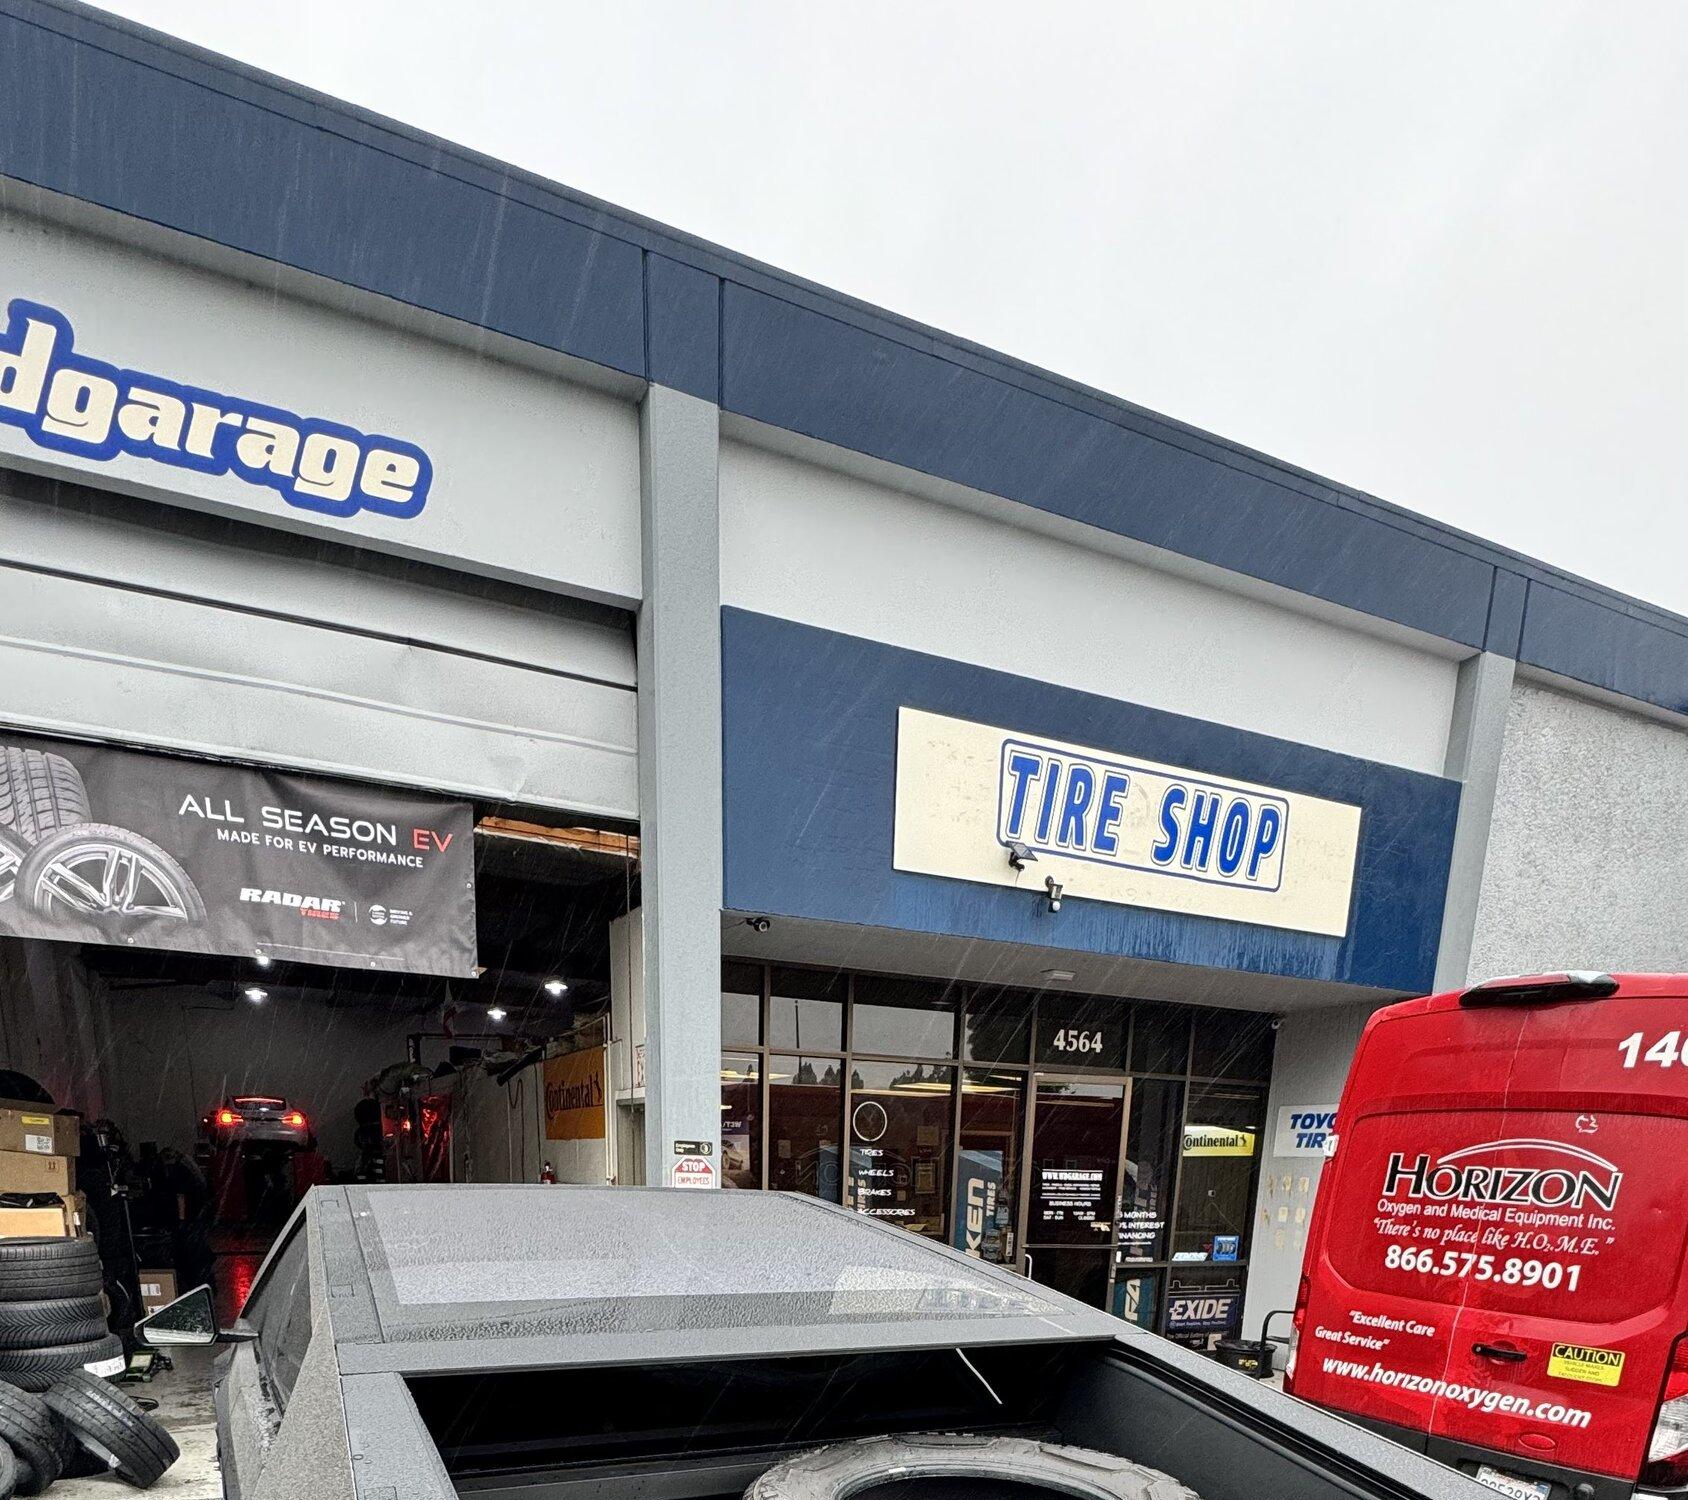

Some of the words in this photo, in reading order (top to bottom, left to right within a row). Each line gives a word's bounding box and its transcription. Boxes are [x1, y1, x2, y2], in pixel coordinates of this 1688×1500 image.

[178, 793, 245, 824] ALL
[261, 805, 398, 847] SEASON
[411, 827, 454, 853] EV
[1006, 749, 1131, 856] TIRE
[1150, 783, 1283, 881] SHOP
[216, 828, 260, 845] MADE
[264, 834, 294, 852] FOR
[298, 840, 318, 855] EV
[323, 845, 425, 869] PERFORMANCE
[239, 887, 343, 914] RADAR
[1053, 1028, 1103, 1053] 4564
[1617, 1030, 1688, 1069] 14
[859, 1148, 884, 1157] TIRES
[1183, 1133, 1239, 1151] Continental
[1295, 1132, 1333, 1148] TIR
[681, 1160, 706, 1172] STOP
[858, 1169, 895, 1177] WHEELS
[677, 1176, 710, 1185] EMPLOYEES
[857, 1188, 892, 1197] BRAKES
[1382, 1152, 1624, 1212] HORIZON
[986, 1181, 997, 1217] TIRES
[1123, 1210, 1158, 1219] MONTHS
[1128, 1221, 1166, 1230] INTEREST
[1377, 1198, 1421, 1217] Oxygen
[1423, 1202, 1448, 1218] and
[1450, 1204, 1501, 1222] Medical
[1504, 1207, 1584, 1229] Equipment
[1587, 1215, 1616, 1231] Inc.
[1117, 1231, 1156, 1240] INANCING
[1422, 1227, 1440, 1239] no
[1440, 1225, 1479, 1246] place
[1481, 1226, 1511, 1250] like
[1384, 1244, 1582, 1292] 866.575.8901
[1169, 1298, 1232, 1321] EXIDE
[1349, 1309, 1405, 1333] "Excellent
[1405, 1319, 1436, 1337] Care
[1314, 1325, 1343, 1342] Great
[1342, 1331, 1391, 1351] Service"
[1554, 1345, 1620, 1366] CAUTION
[1322, 1356, 1593, 1428] www.horizonoxygen.com
